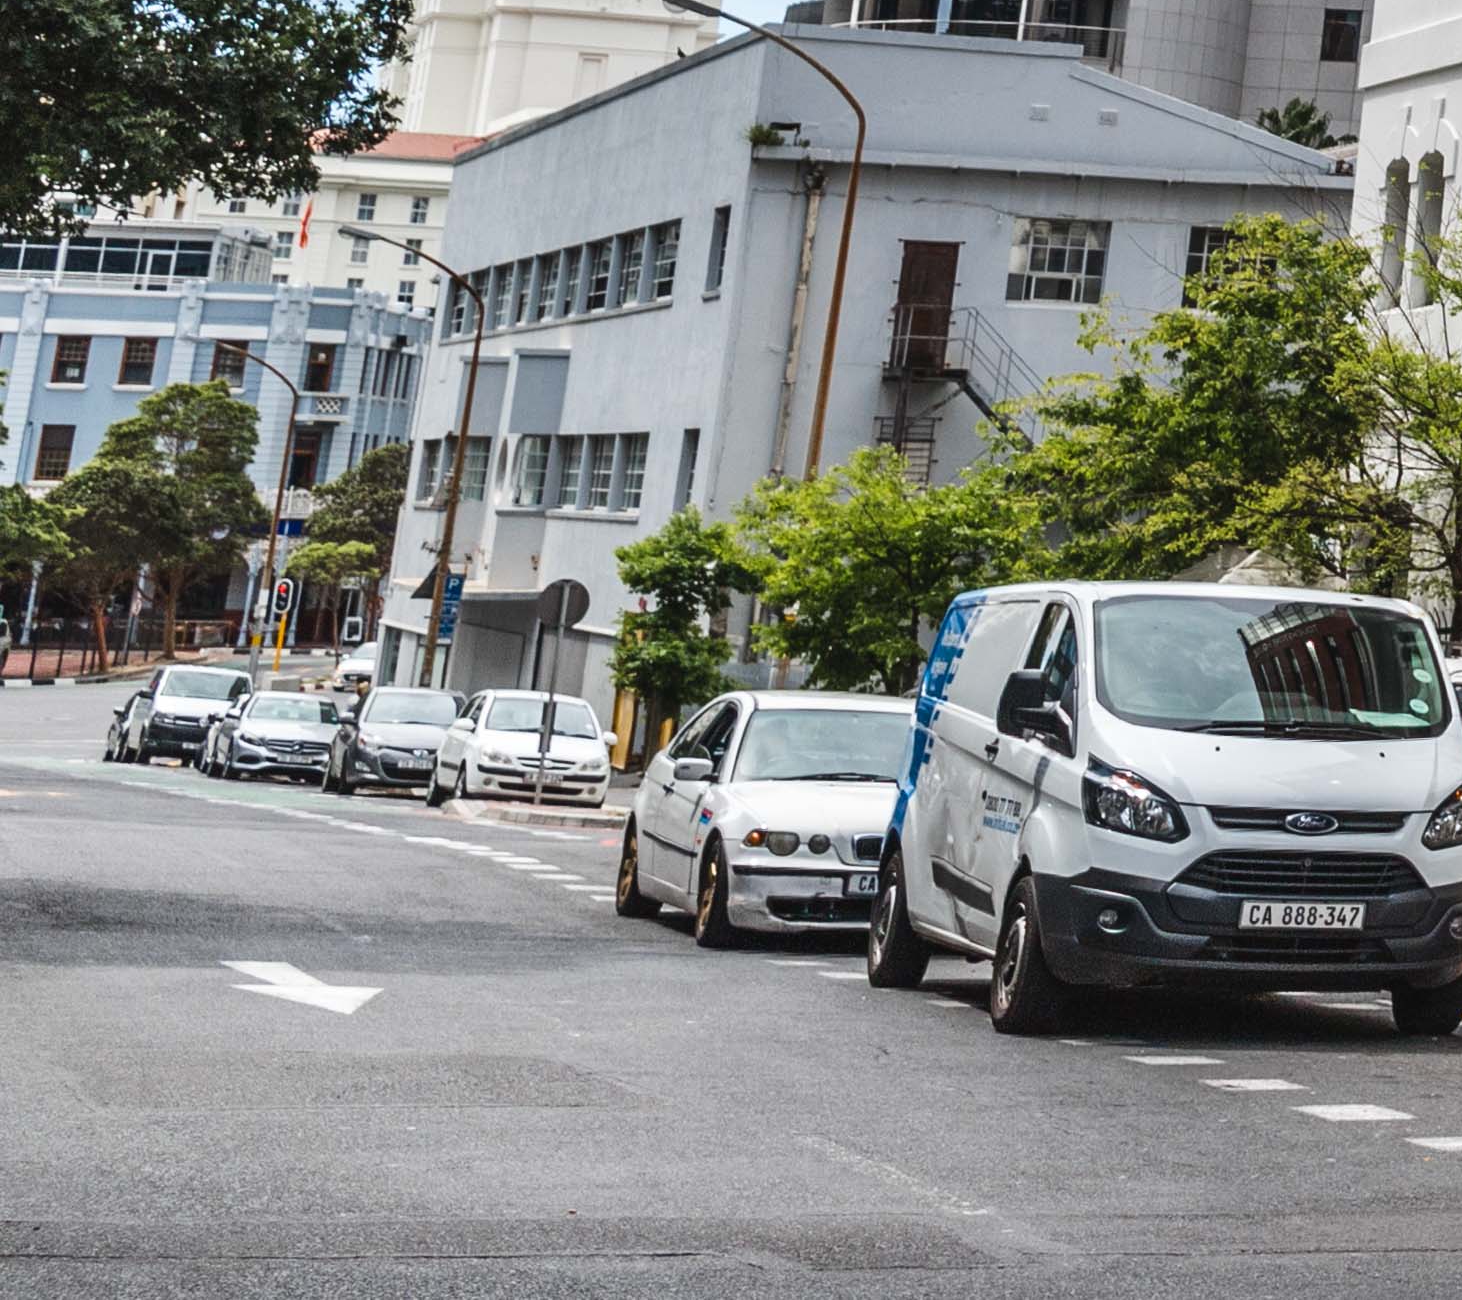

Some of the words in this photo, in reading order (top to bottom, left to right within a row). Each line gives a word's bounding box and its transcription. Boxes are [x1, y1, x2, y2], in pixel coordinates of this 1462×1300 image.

[448, 578, 460, 589] P
[859, 876, 876, 891] CA
[1249, 905, 1272, 925] CA
